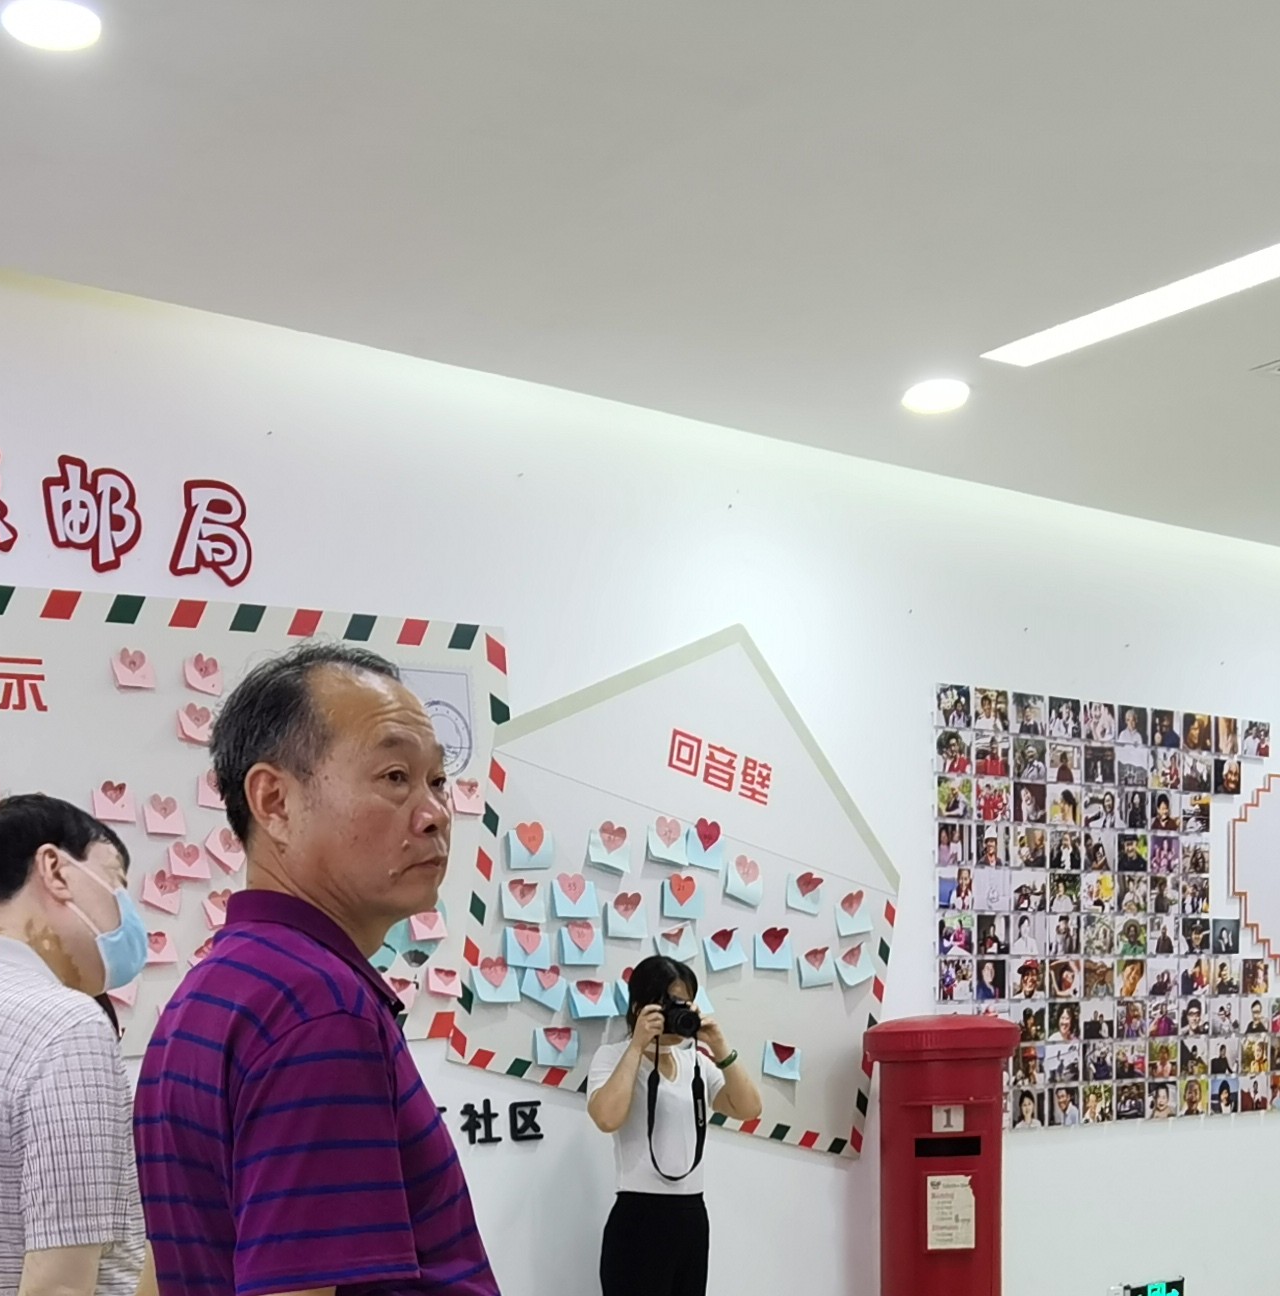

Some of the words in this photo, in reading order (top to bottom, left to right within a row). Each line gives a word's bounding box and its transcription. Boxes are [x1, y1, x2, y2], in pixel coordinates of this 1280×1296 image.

[668, 728, 772, 806] 回音壁
[436, 1099, 544, 1144] 社区
[943, 1108, 954, 1128] 1
